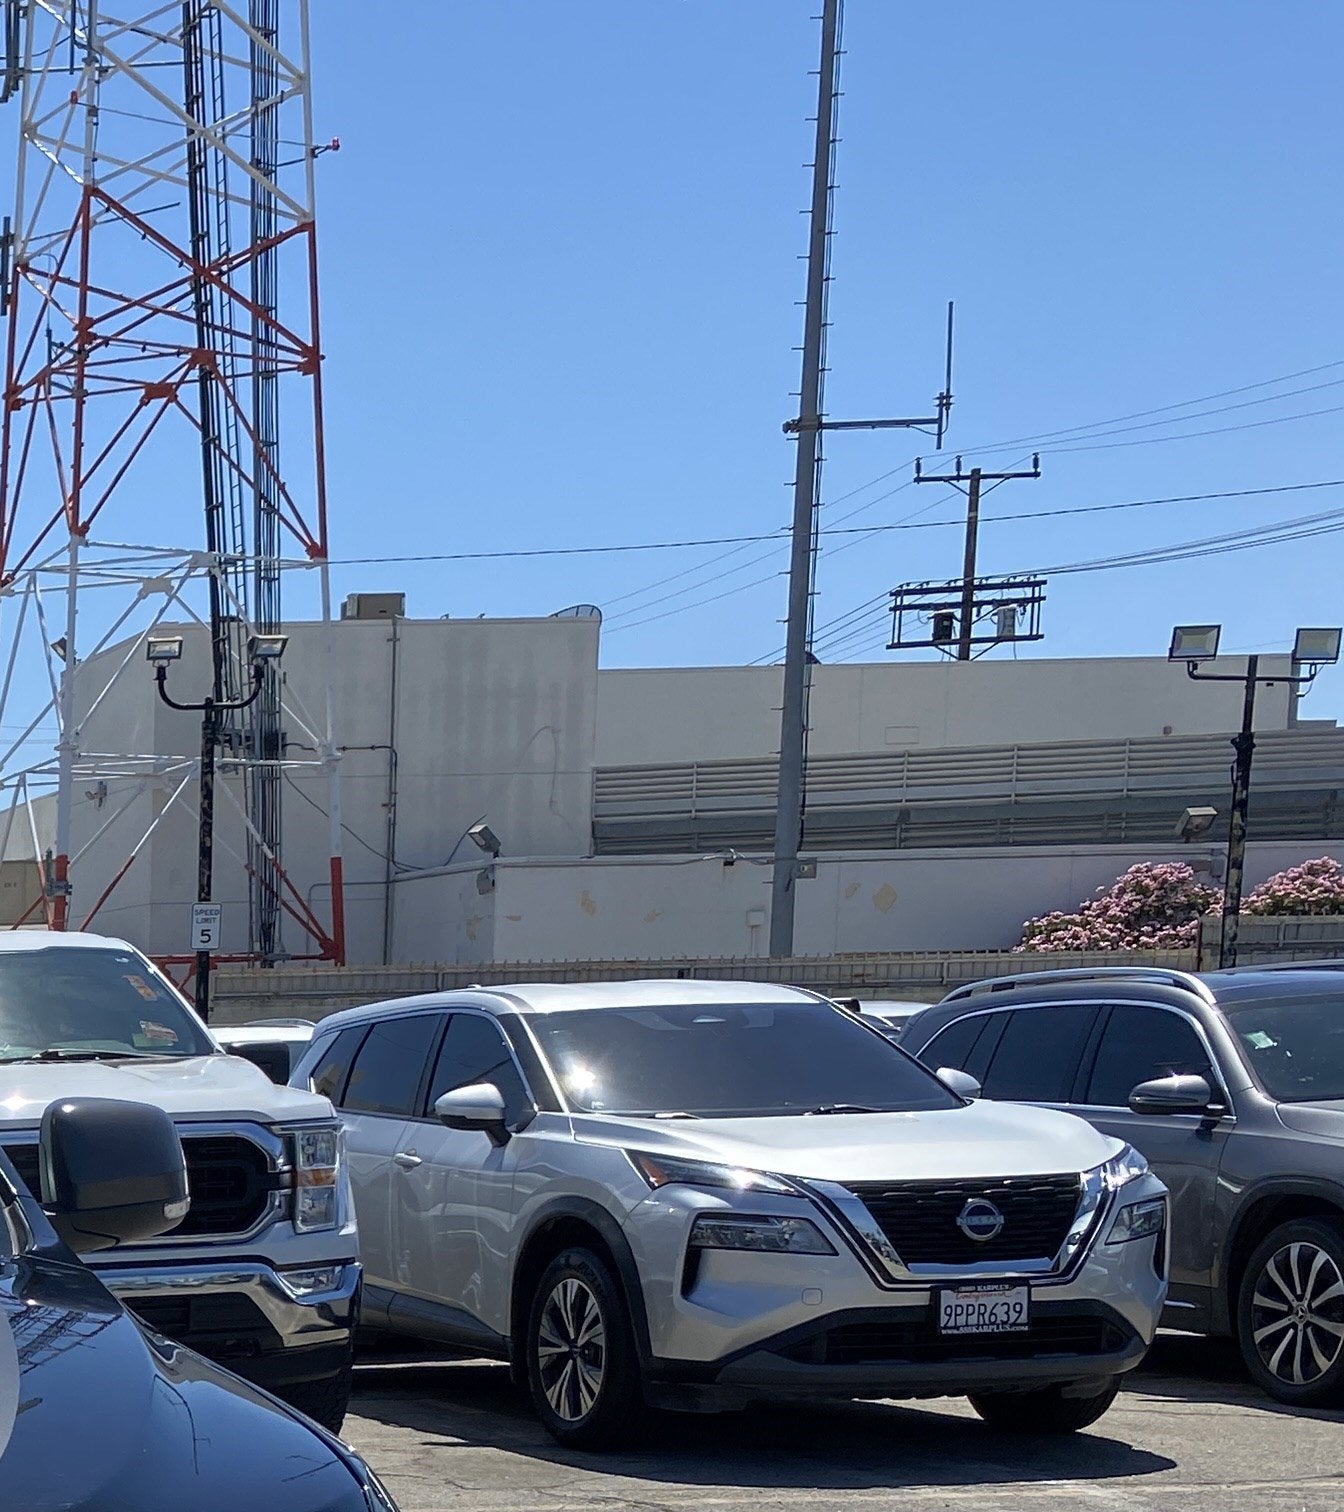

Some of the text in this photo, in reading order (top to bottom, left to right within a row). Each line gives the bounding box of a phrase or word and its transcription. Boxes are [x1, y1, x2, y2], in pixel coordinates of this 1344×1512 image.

[194, 908, 220, 916] SPEED
[200, 929, 212, 943] 5
[943, 1302, 1024, 1328] 9PPR639
